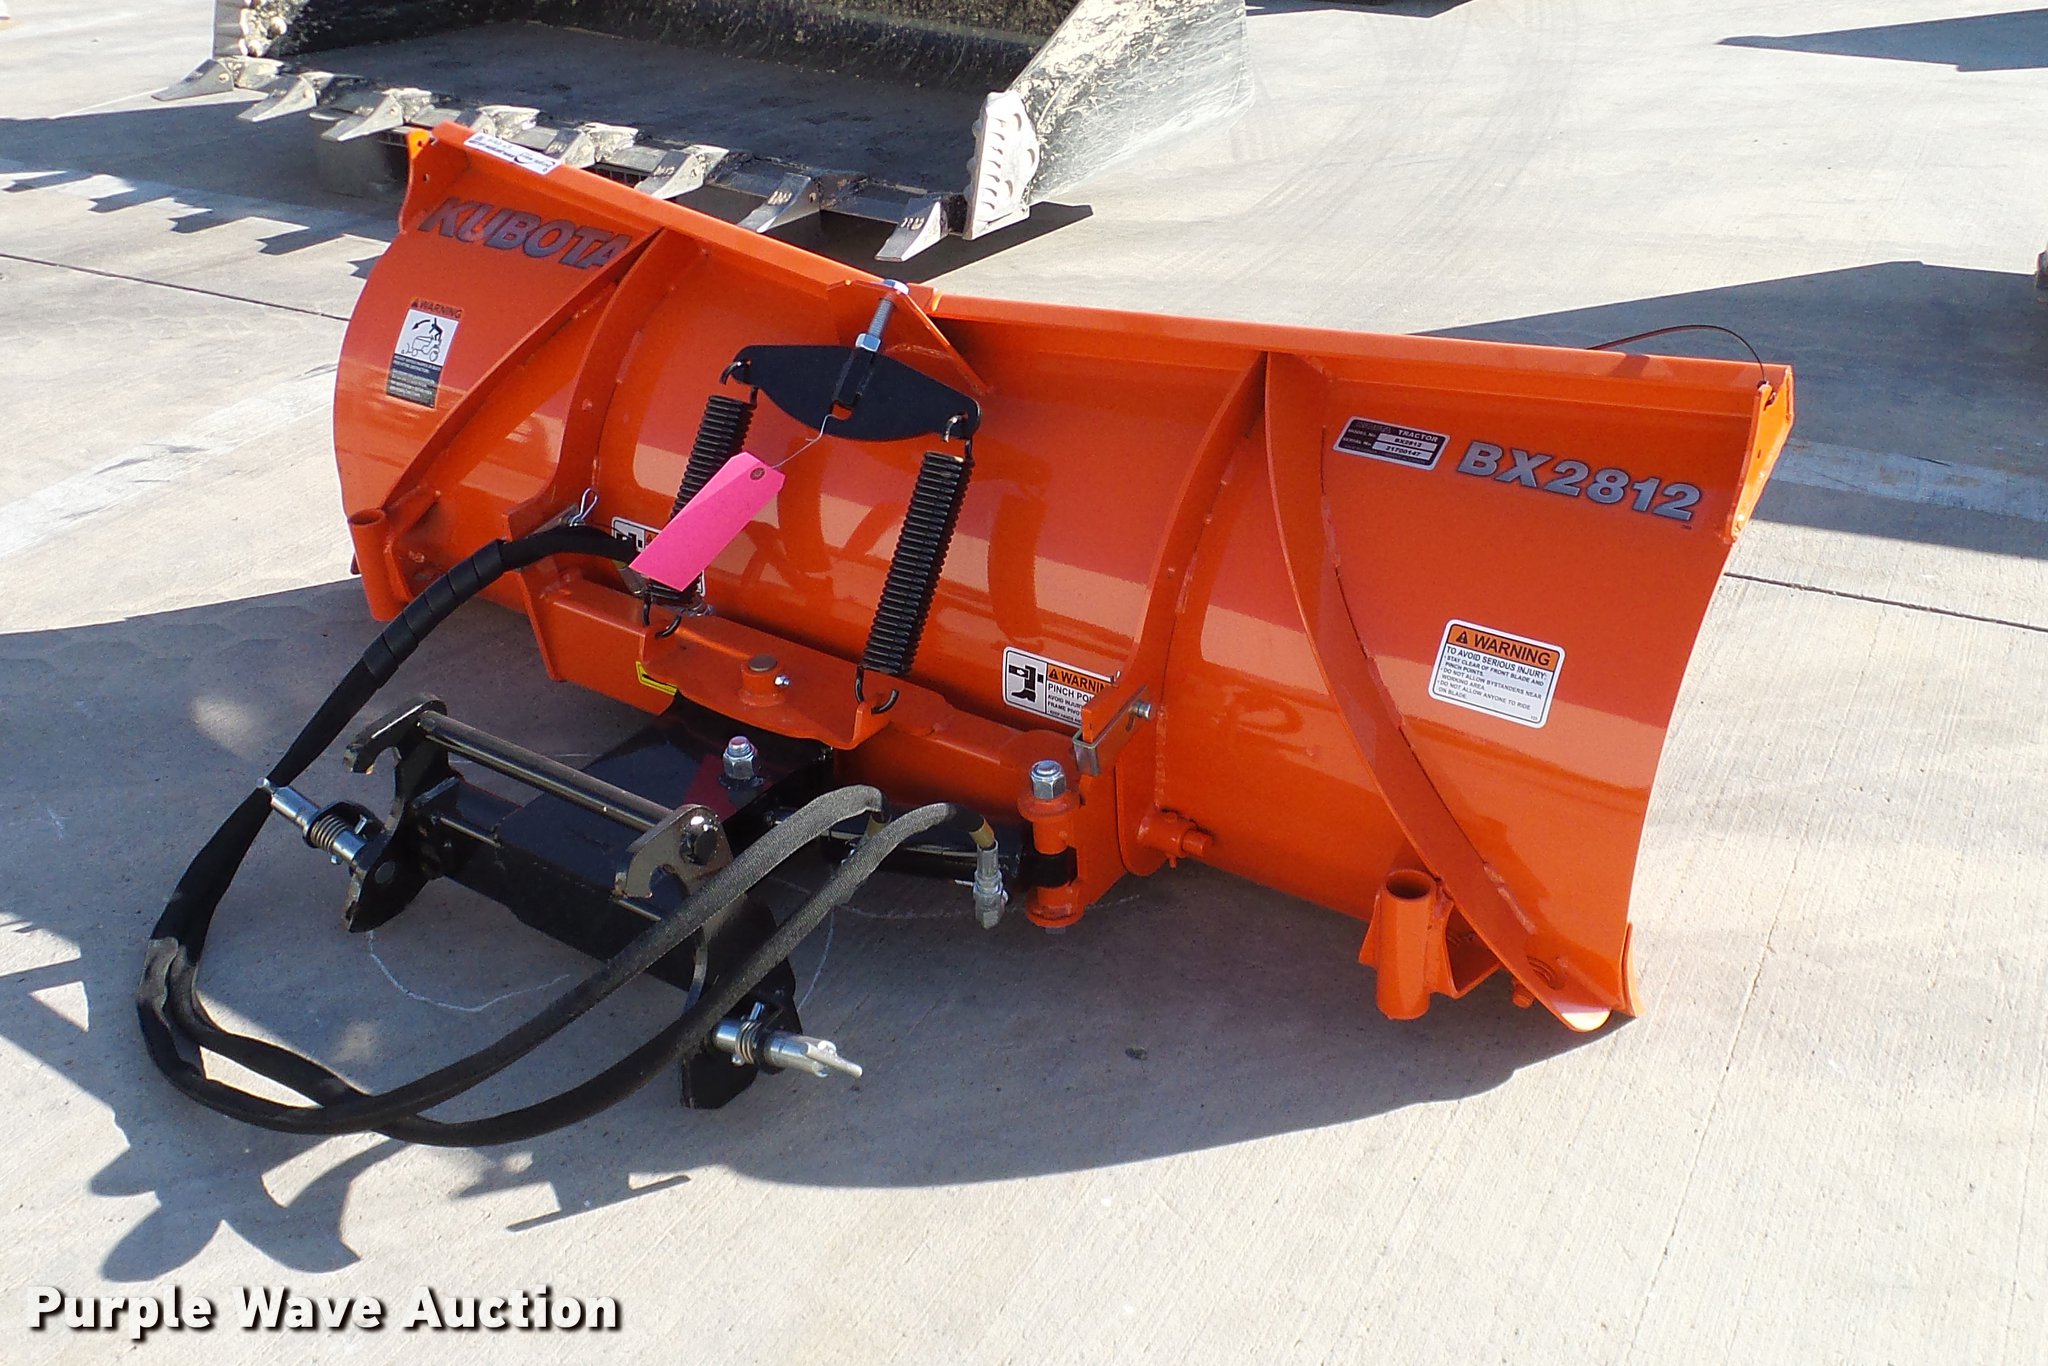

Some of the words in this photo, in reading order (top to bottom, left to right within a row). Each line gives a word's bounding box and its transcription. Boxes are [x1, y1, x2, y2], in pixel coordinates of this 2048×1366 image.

[418, 196, 632, 269] KUBOTA
[419, 301, 463, 319] WARNING
[1394, 438, 1423, 448] BX2812
[1398, 430, 1438, 443] TRACTOR
[1457, 440, 1702, 522] BX2812
[1446, 646, 1457, 654] TO
[1457, 649, 1481, 662] AVOID
[1482, 656, 1516, 671] SERIOUS
[1474, 633, 1551, 667] WARNING
[1445, 662, 1462, 670] PINCH
[1447, 655, 1460, 663] STAY
[1461, 660, 1480, 669] CLEAR
[1490, 667, 1509, 677] FRONT
[1510, 673, 1530, 683] BLADE
[1048, 683, 1074, 698] PINCH
[1061, 670, 1105, 693] WARNIN
[1442, 674, 1468, 686] WORKING
[1465, 674, 1485, 683] ALLOW
[1486, 680, 1524, 694] BYSTANDERS
[1526, 690, 1542, 700] NEAR
[1048, 701, 1066, 711] FRAME
[1462, 686, 1482, 696] ALLOW
[1483, 693, 1506, 703] ANYONE
[1517, 702, 1531, 710] RIDE
